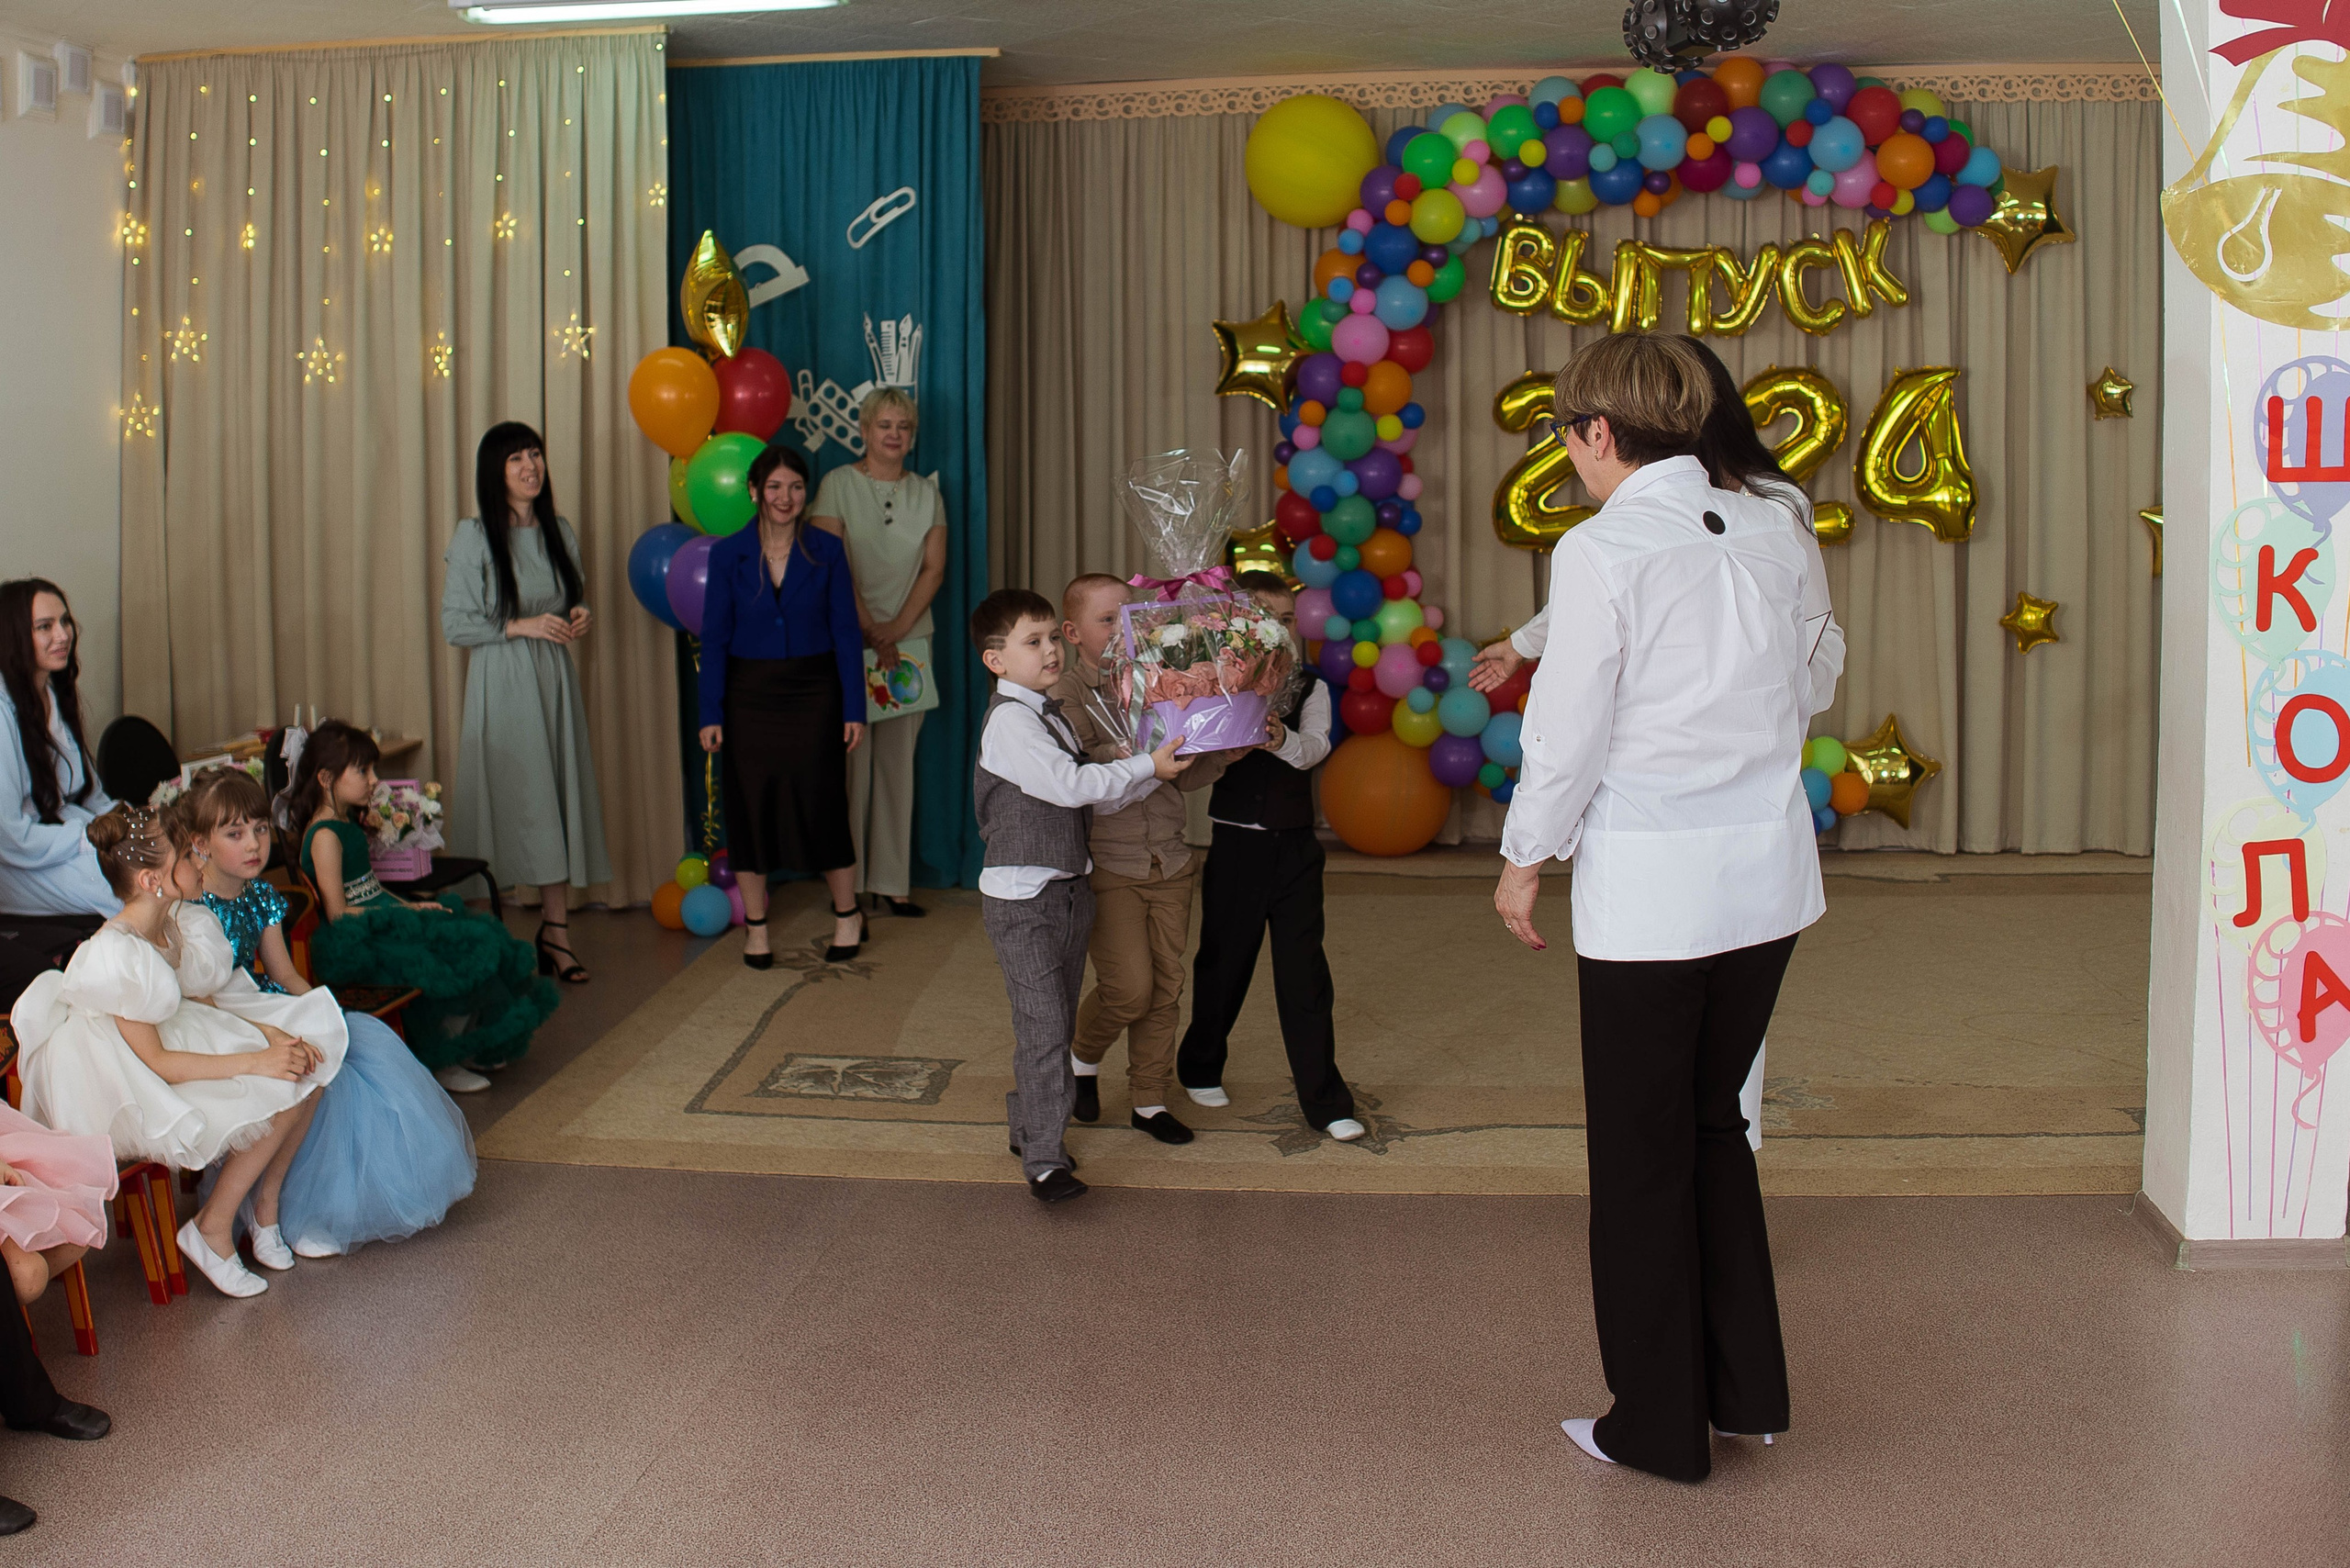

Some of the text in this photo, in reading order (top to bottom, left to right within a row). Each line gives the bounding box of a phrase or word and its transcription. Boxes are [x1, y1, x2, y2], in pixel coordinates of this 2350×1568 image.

[1490, 216, 1908, 337] ВЫПУСК
[1494, 365, 1979, 551] 224
[2232, 396, 2350, 1043] ШКОЛА
